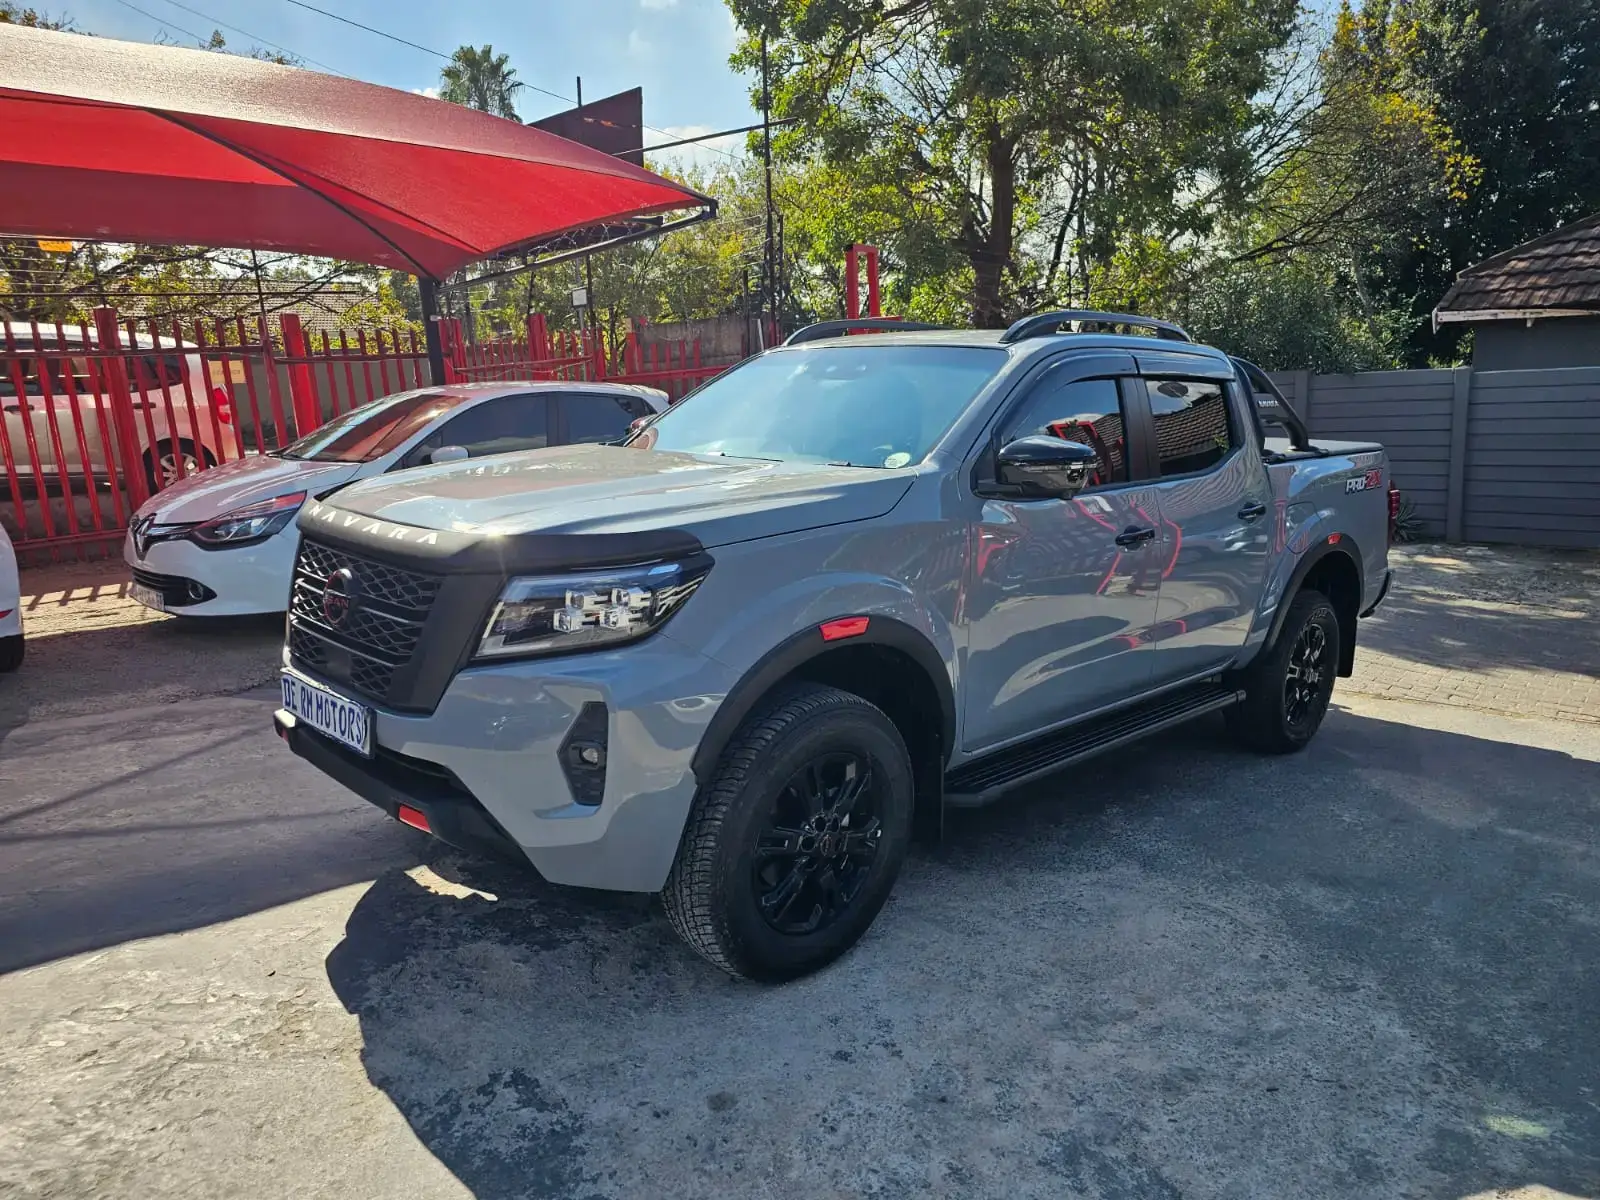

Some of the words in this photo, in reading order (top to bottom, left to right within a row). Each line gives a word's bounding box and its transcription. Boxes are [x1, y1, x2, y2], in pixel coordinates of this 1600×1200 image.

[309, 505, 438, 544] NAVARA
[283, 678, 298, 711] DE
[316, 693, 362, 745] MOTORS
